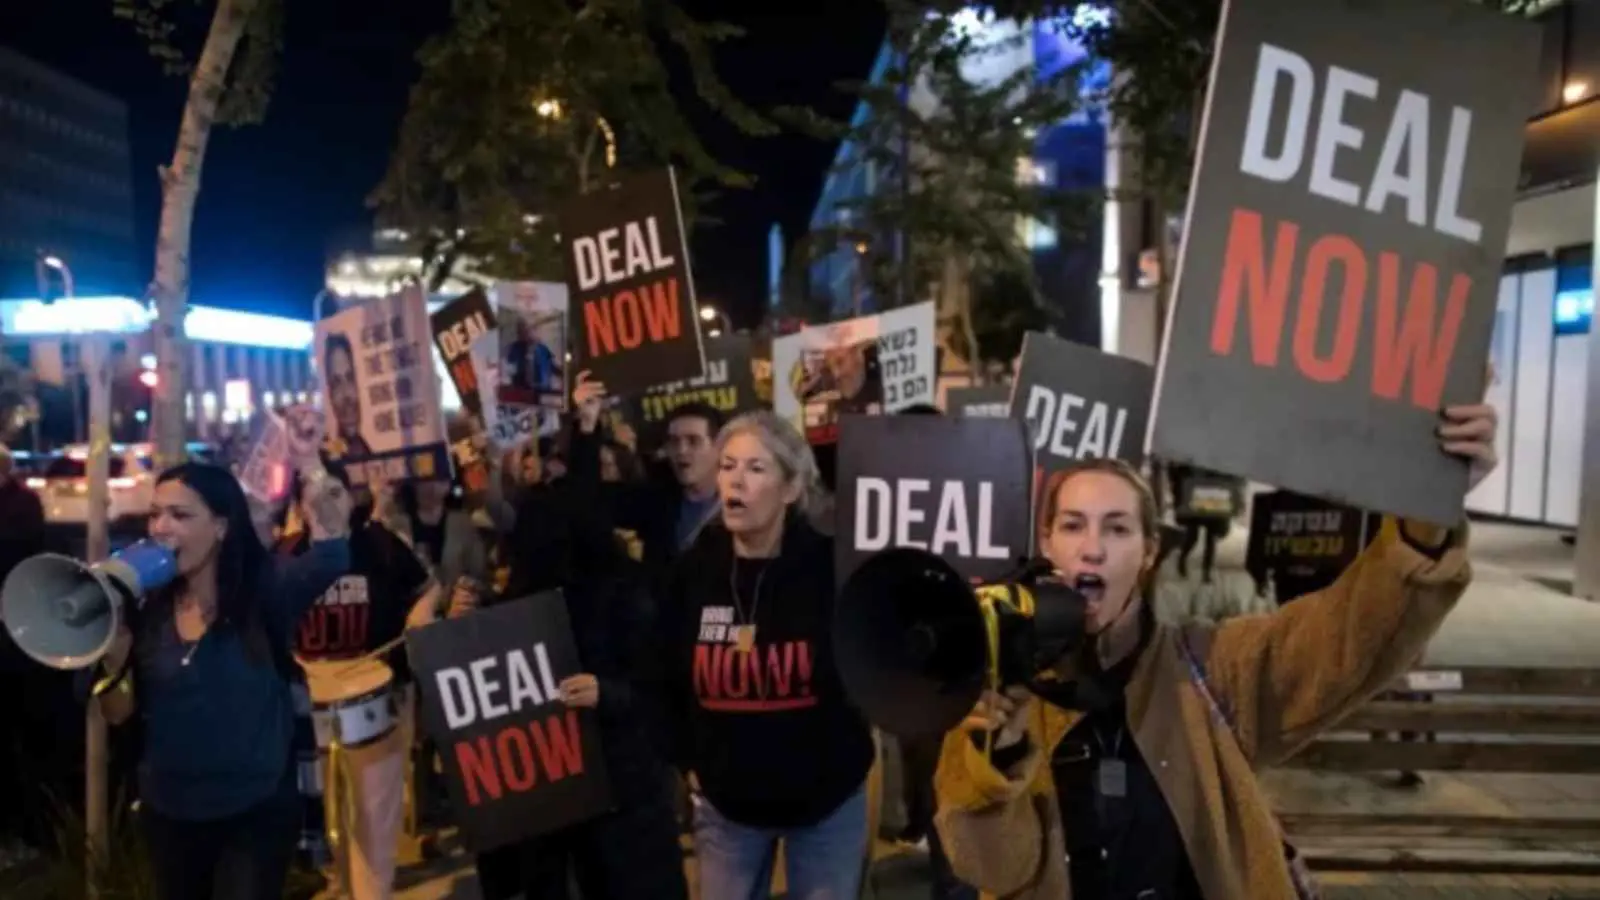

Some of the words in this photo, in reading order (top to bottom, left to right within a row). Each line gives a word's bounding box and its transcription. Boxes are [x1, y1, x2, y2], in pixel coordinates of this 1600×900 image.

[1240, 43, 1482, 242] DEAL
[572, 216, 675, 290] DEAL
[584, 277, 680, 357] NOW
[1210, 207, 1472, 412] NOW
[1026, 384, 1128, 461] DEAL
[855, 476, 1009, 559] DEAL
[435, 642, 561, 730] DEAL
[693, 641, 812, 698] NOW!
[454, 711, 583, 807] NOW
